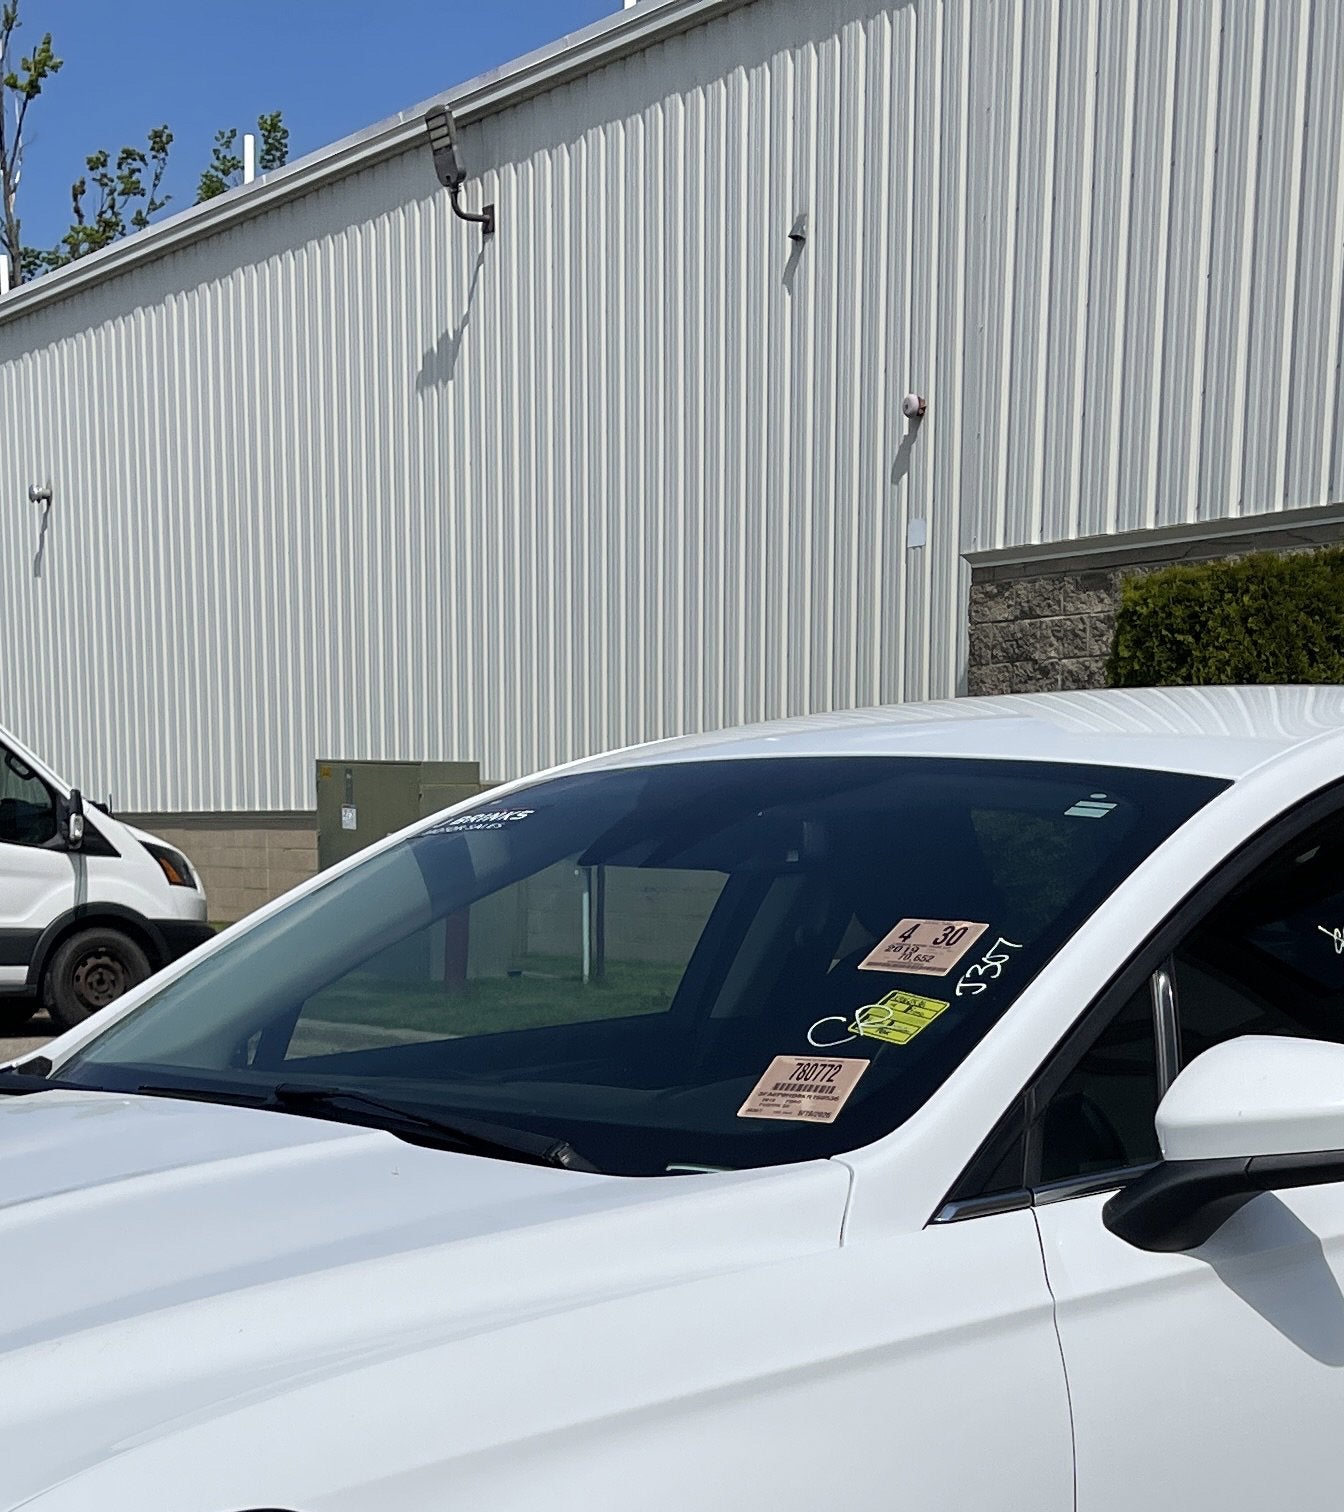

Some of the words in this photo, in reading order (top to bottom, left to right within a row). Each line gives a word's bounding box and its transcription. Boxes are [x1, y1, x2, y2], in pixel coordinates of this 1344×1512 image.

[898, 923, 921, 943] 4
[932, 925, 969, 946] 30
[788, 1062, 843, 1083] 780772
